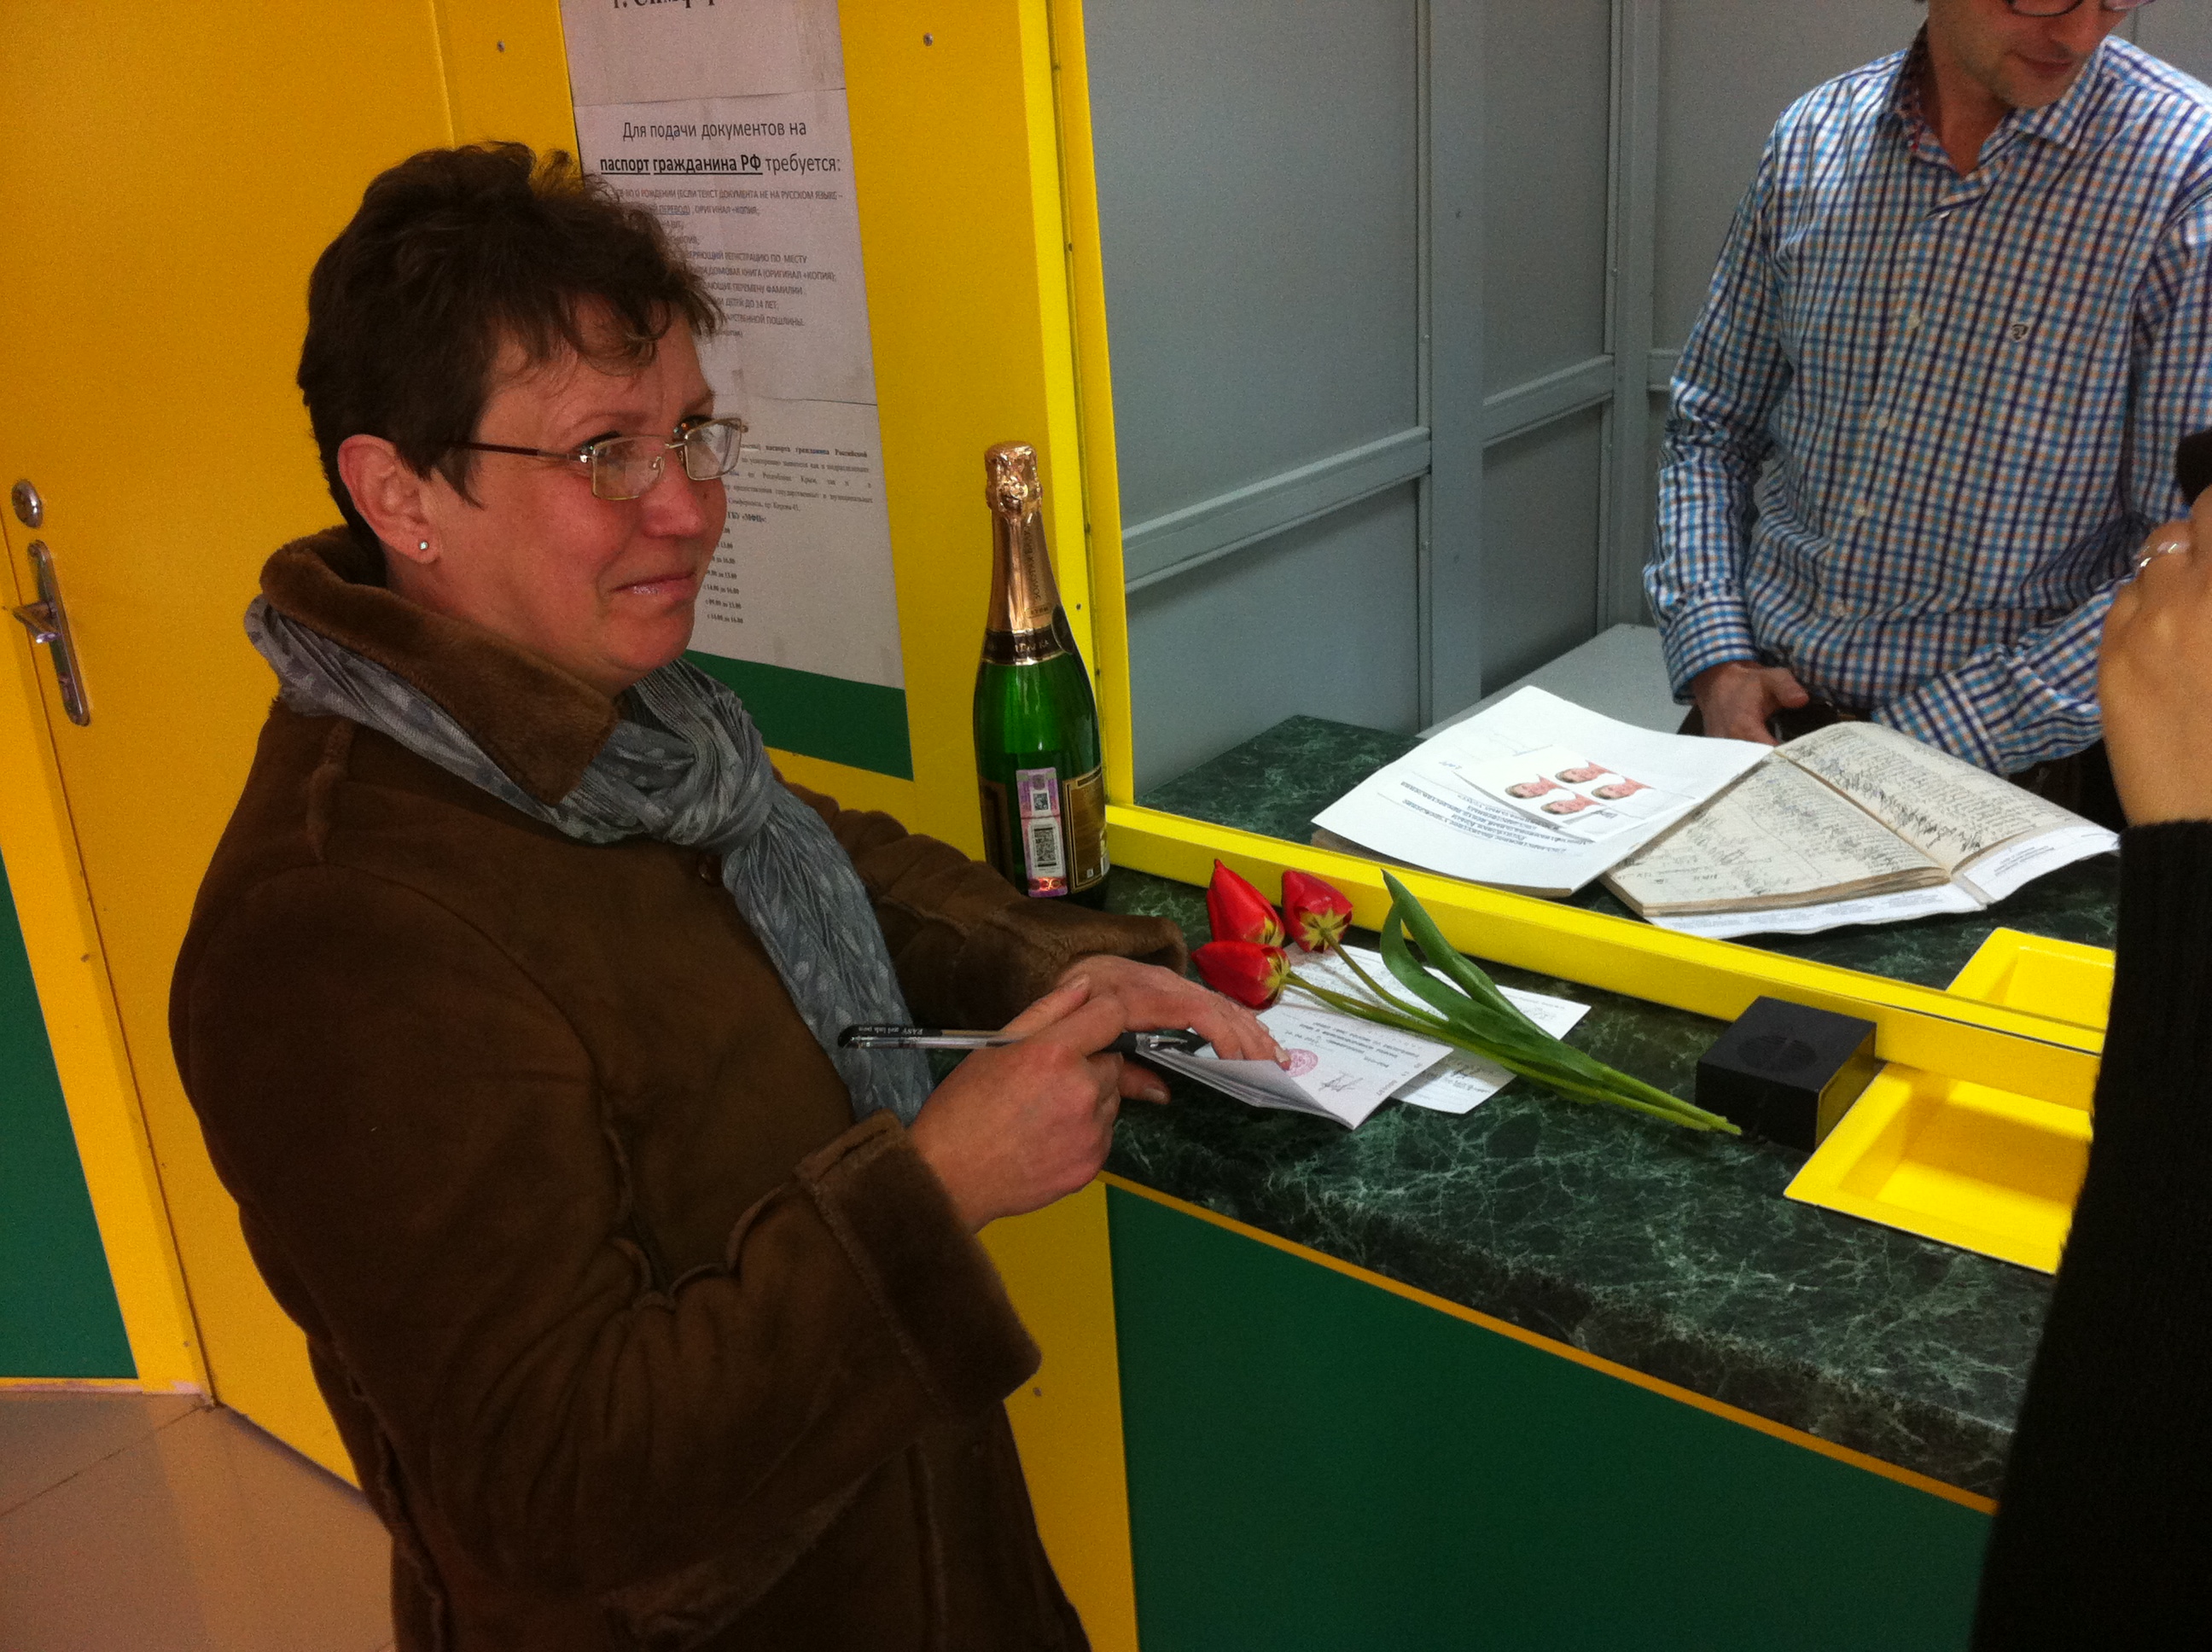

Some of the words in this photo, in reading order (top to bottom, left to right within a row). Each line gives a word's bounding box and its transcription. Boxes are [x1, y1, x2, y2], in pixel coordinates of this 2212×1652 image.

[623, 122, 647, 142] Для
[650, 125, 697, 141] подачи
[701, 122, 785, 140] документов
[789, 122, 807, 136] на
[600, 158, 649, 174] паспорт
[653, 156, 737, 174] гражданина
[741, 154, 761, 172] РФ
[765, 153, 841, 176] требуется:
[641, 189, 677, 198] РОЖДЕНИИ
[678, 189, 697, 200] (ЕСЛИ
[698, 189, 719, 199] ТЕКСТ
[719, 189, 759, 200] ДОКУМЕНТА
[760, 190, 770, 199] НЕ
[771, 190, 780, 200] НА
[781, 190, 814, 200] РУССКОМ
[770, 253, 781, 262] ПО
[783, 254, 807, 263] МЕСТУ
